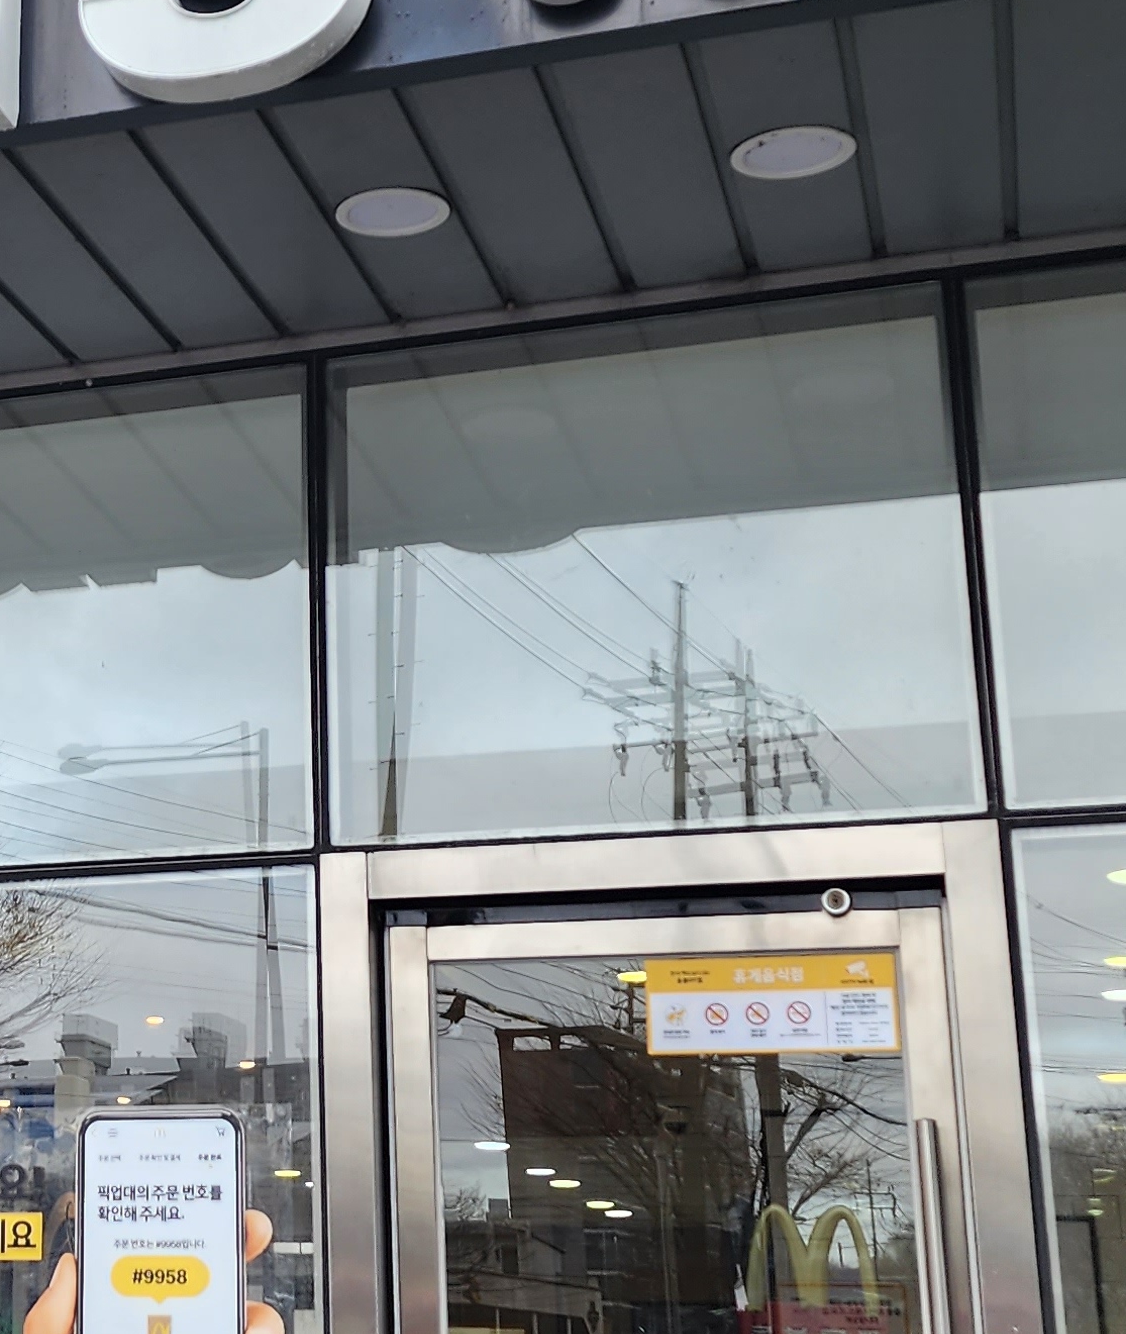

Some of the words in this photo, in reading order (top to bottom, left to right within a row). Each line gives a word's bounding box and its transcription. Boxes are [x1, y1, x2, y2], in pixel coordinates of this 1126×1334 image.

[97, 1184, 149, 1202] 픽업대의
[151, 1184, 179, 1202] 주문
[182, 1183, 223, 1202] 번호를
[97, 1205, 137, 1222] 확인해
[140, 1205, 185, 1222] 주세요.
[132, 1268, 188, 1285] #9958
